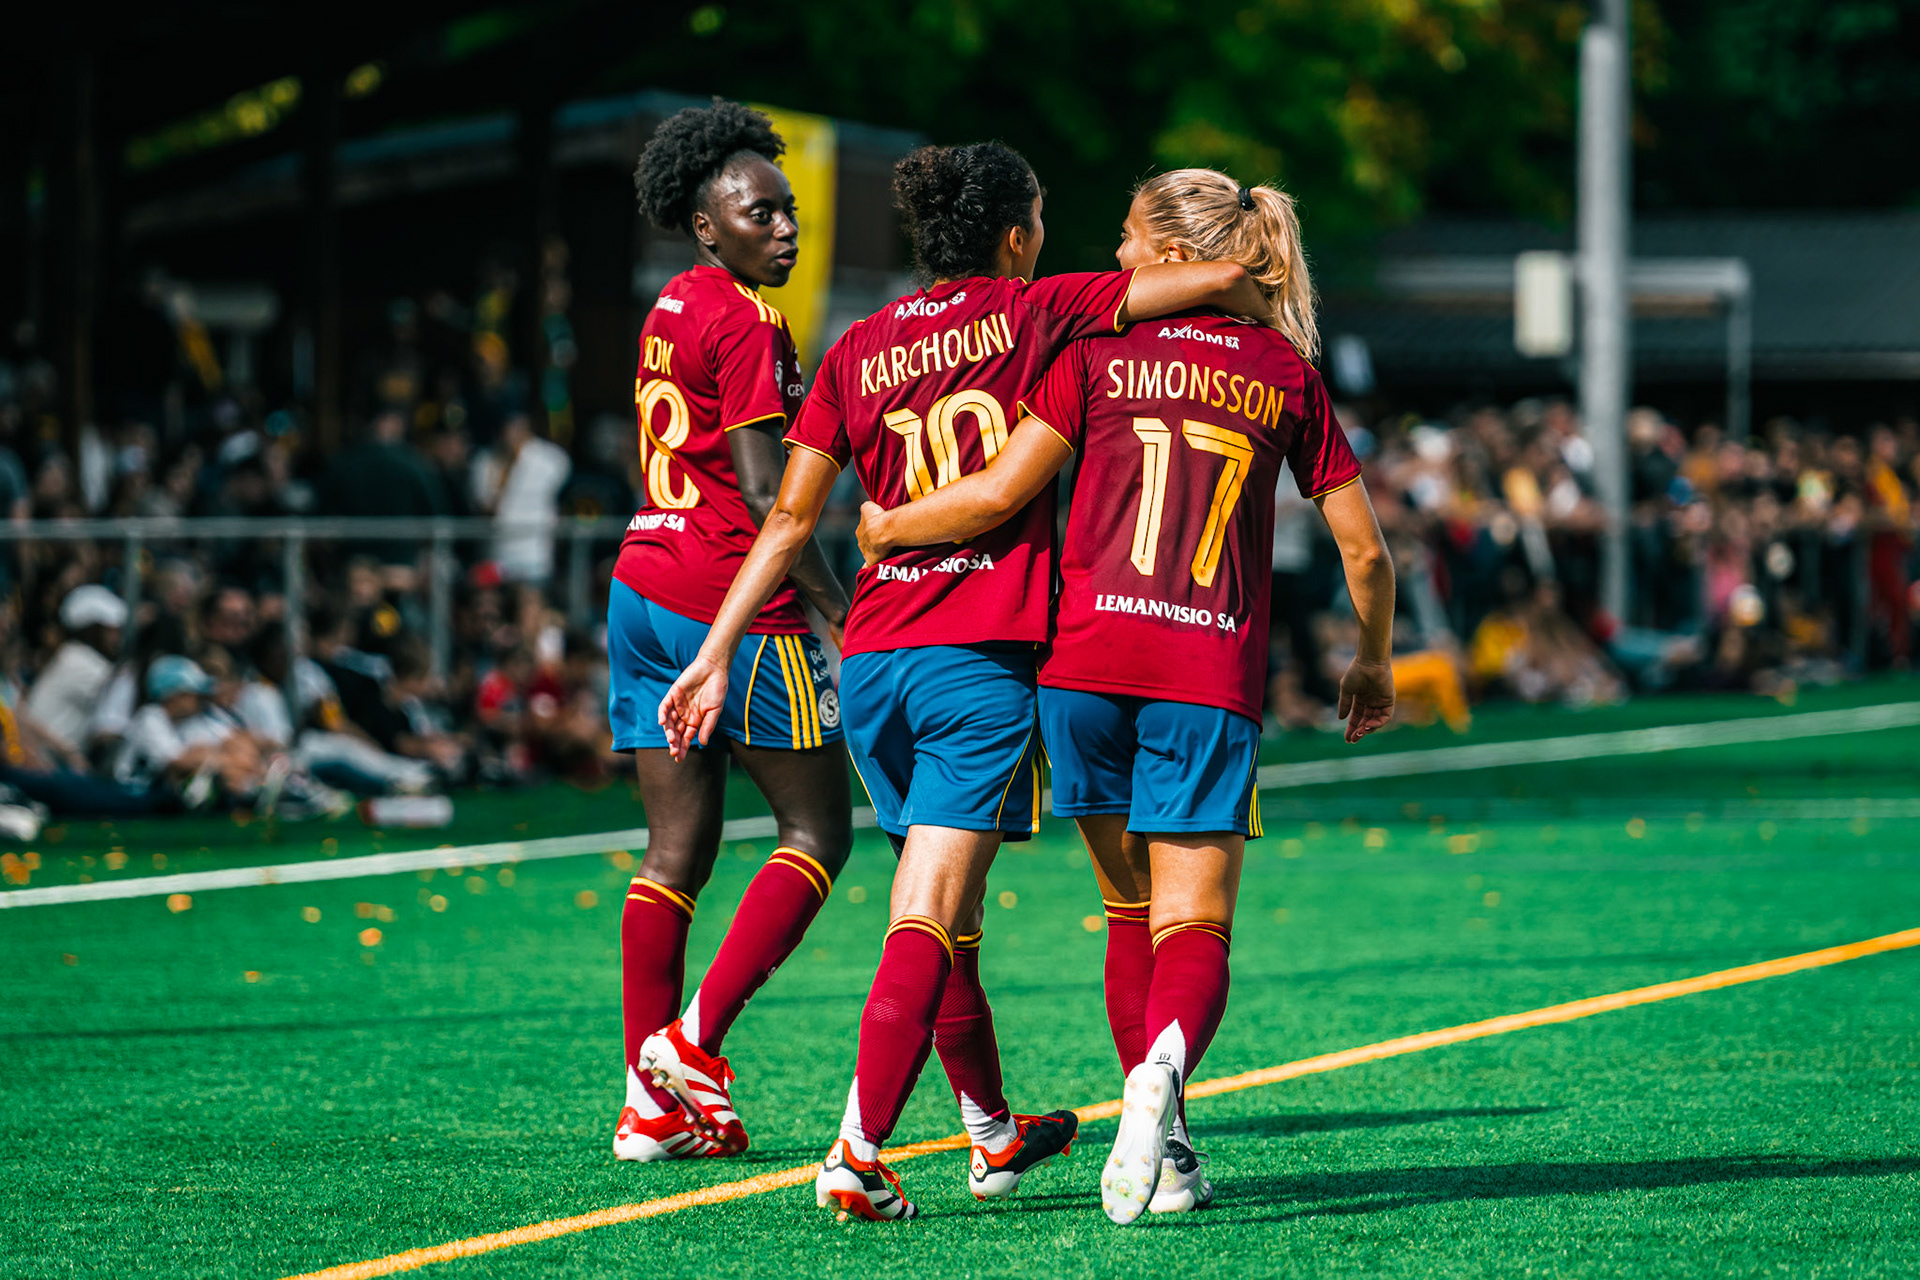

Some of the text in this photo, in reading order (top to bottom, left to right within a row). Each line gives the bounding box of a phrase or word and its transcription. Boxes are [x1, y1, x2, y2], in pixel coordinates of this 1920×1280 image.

[861, 313, 1014, 397] KARCHOUNI
[1157, 324, 1222, 345] AXIOM
[1106, 359, 1285, 429] SIMONSSON
[883, 389, 1009, 502] 10
[664, 513, 686, 532] SA
[1130, 417, 1255, 588] 17
[1095, 594, 1237, 633] LEMANVISIO SA
